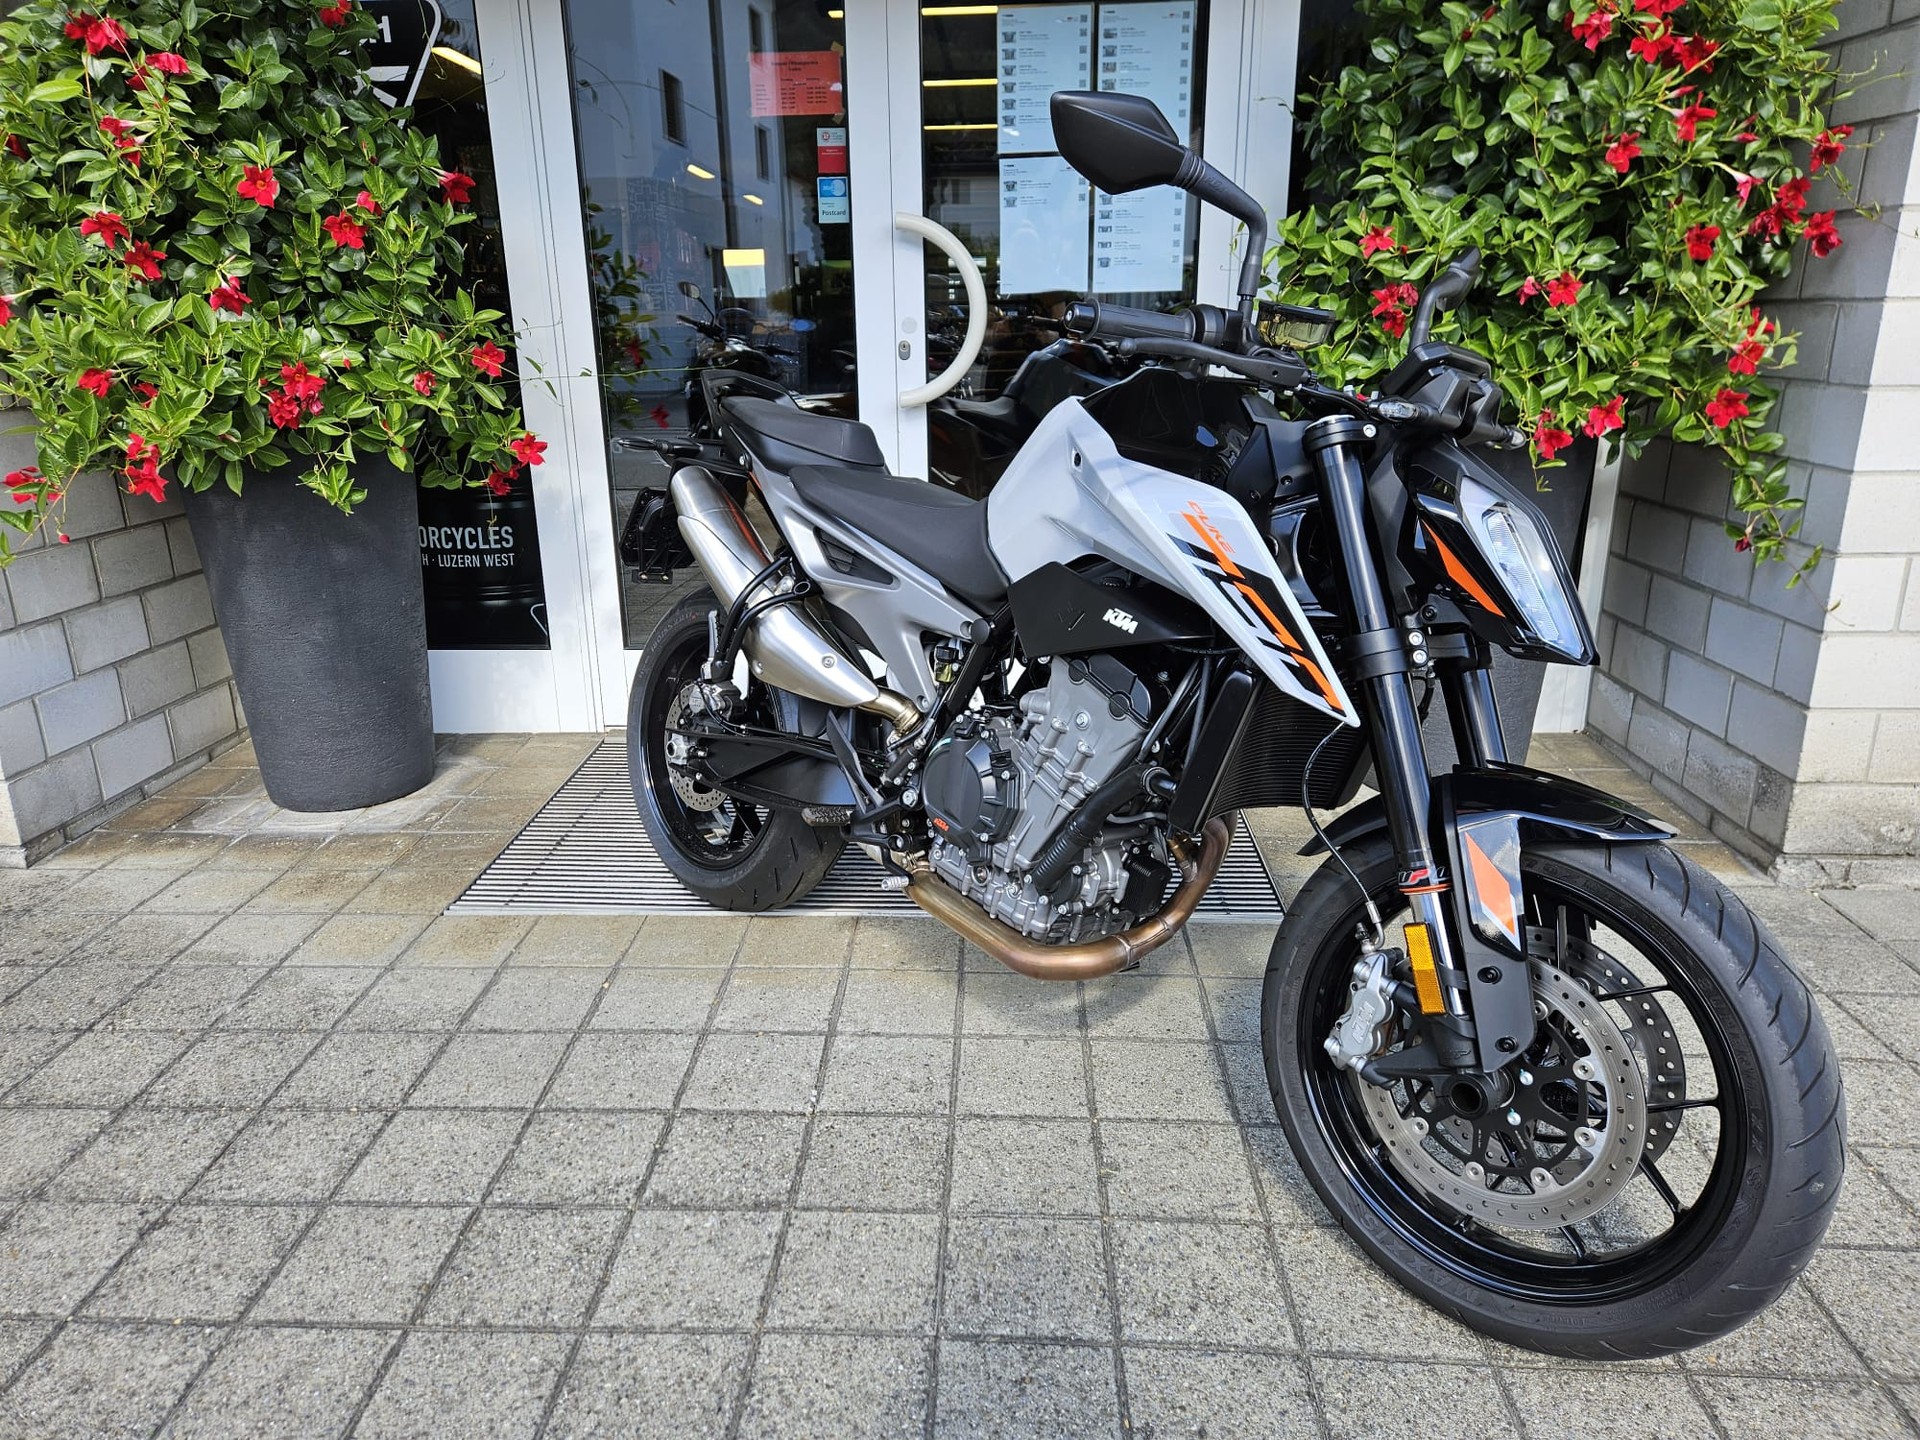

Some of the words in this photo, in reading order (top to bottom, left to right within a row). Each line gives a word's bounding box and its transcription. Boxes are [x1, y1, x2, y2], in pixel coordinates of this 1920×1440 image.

[821, 208, 847, 217] Postcard
[1187, 500, 1236, 554] DUKE
[437, 554, 480, 568] LUZERN
[484, 552, 515, 568] WEST
[1102, 607, 1139, 635] KTM
[933, 817, 951, 832] KTM
